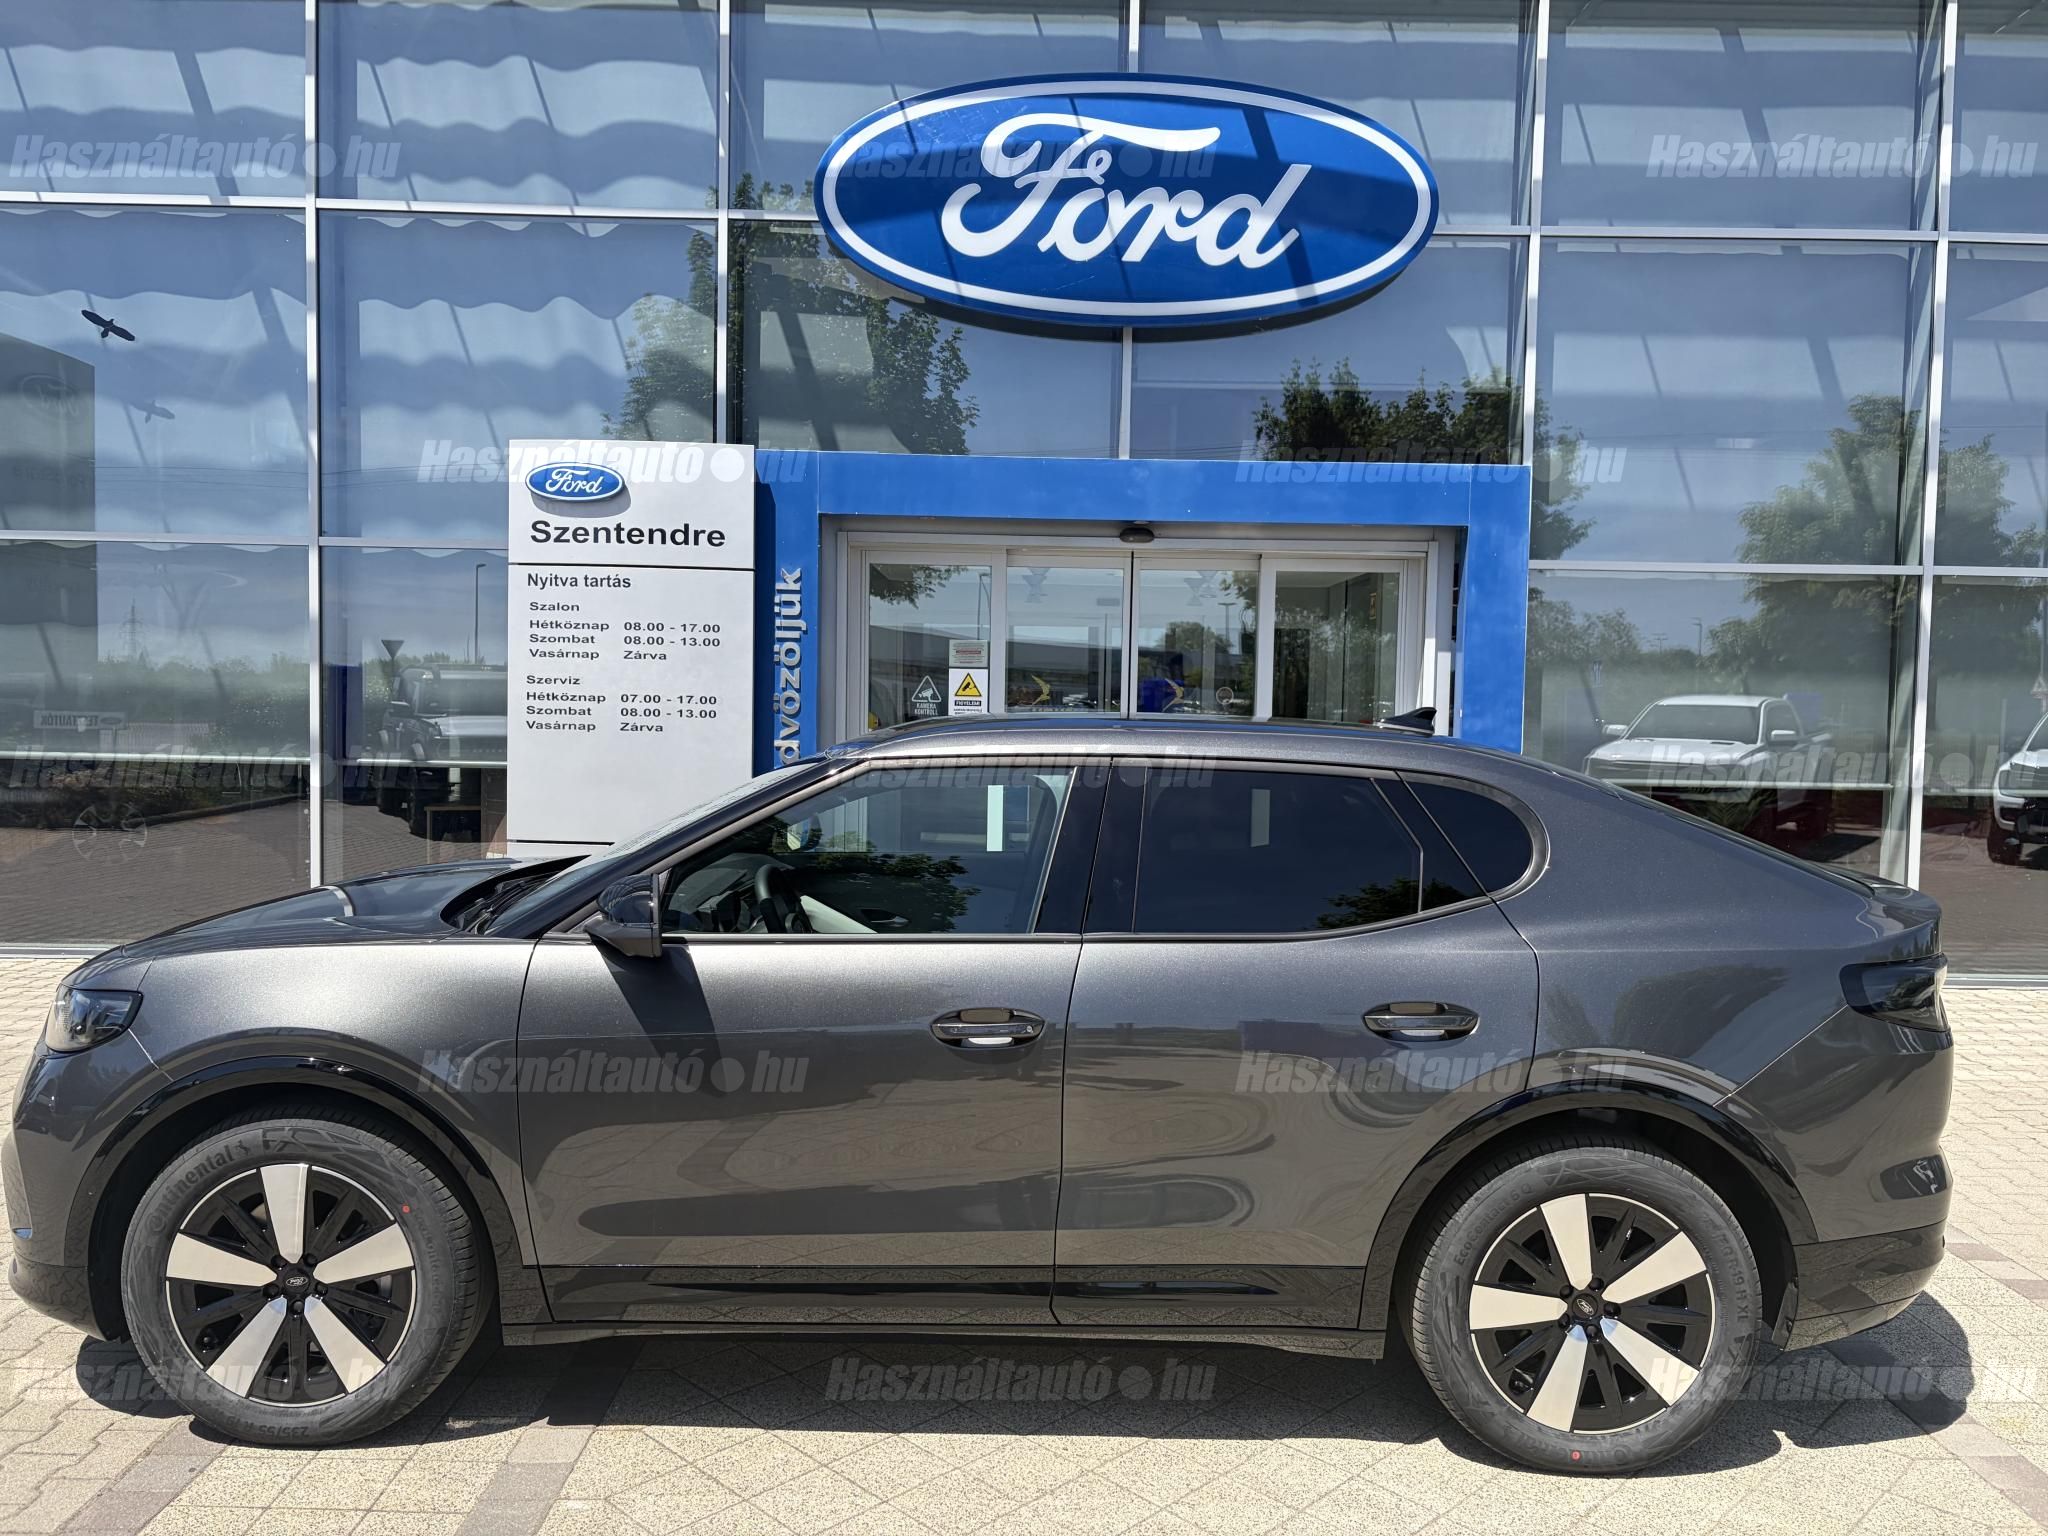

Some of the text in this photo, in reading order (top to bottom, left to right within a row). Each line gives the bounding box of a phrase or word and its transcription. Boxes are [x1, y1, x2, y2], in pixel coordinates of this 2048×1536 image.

[941, 113, 1312, 268] Ford
[545, 467, 604, 494] Ford
[530, 520, 726, 547] Szentendre
[527, 573, 631, 590] Nyitva tartás
[529, 602, 580, 612] Szalon
[529, 619, 610, 632] Hétköznap
[623, 621, 665, 632] 08.00
[680, 623, 721, 634] 17.00
[529, 633, 596, 645] Szombat
[623, 635, 665, 646] 08.00
[680, 637, 721, 648] 13.00
[528, 648, 667, 661] Vasárnap Zárva
[526, 675, 581, 686] Szerviz
[526, 691, 606, 704] Hétköznap
[620, 693, 661, 704] 07.00
[676, 695, 717, 705] 17.00
[526, 705, 592, 717] Szombat
[620, 708, 661, 718] 08.00
[676, 709, 717, 719] 13.00
[526, 720, 664, 733] Vasárnap Zárva
[146, 1145, 234, 1234] Continental
